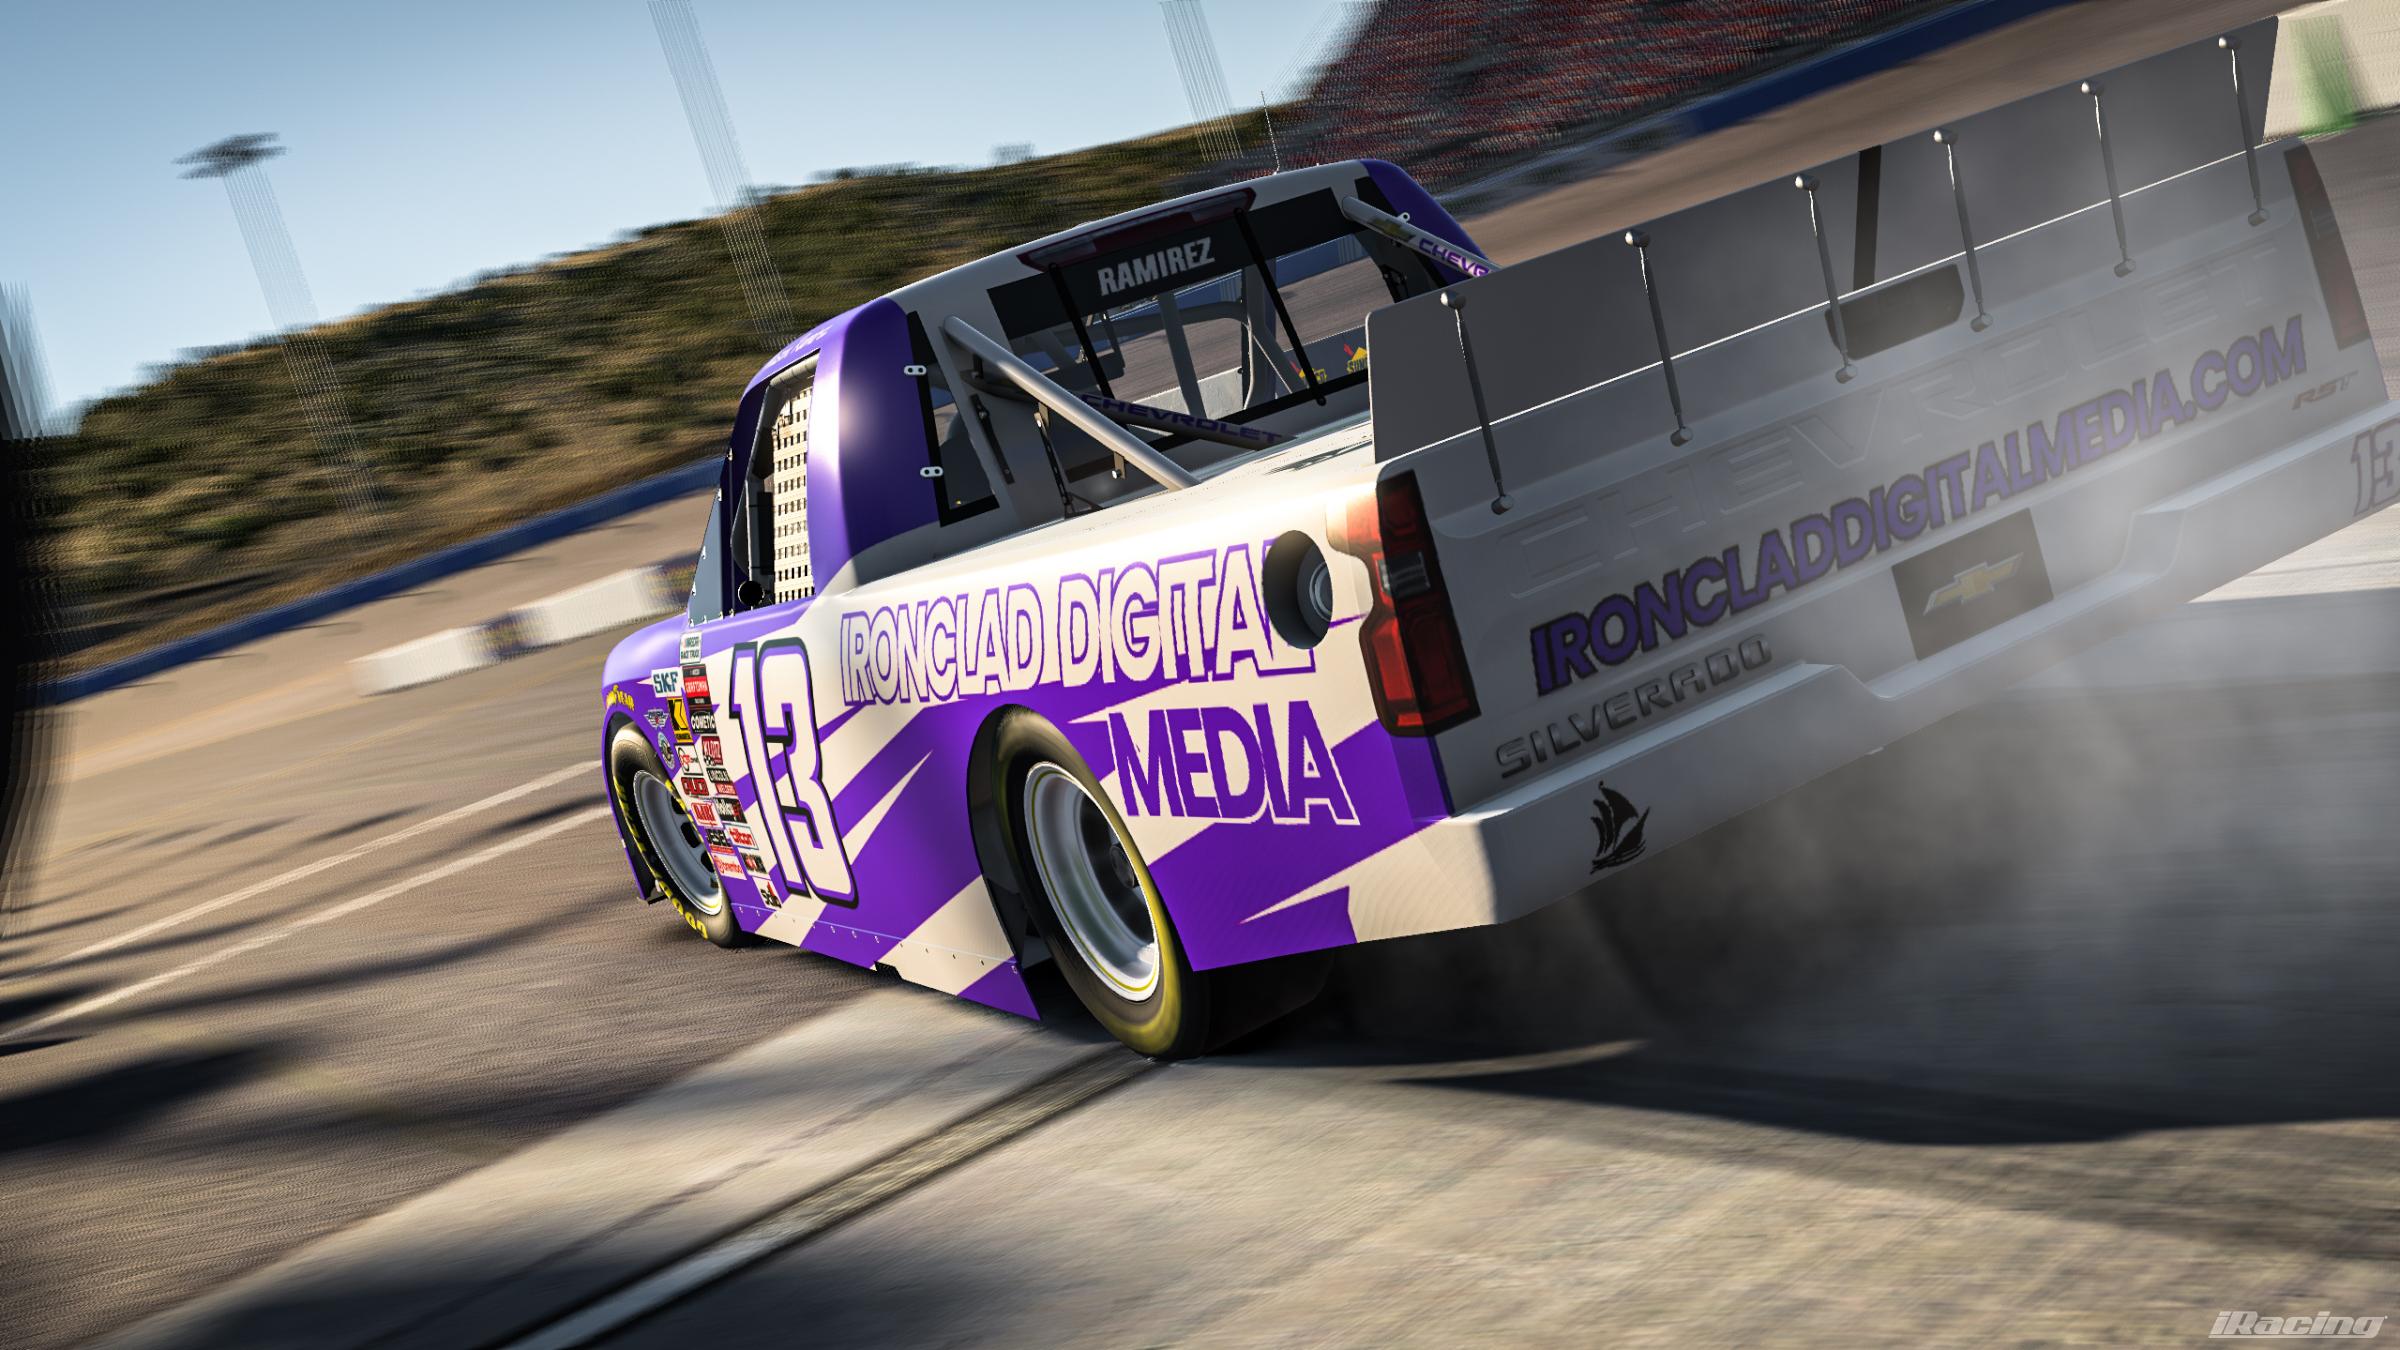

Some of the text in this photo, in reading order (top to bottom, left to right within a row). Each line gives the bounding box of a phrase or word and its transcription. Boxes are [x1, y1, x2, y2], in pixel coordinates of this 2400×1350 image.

[1098, 237, 1215, 297] RAMIREZ
[1418, 237, 1489, 277] CHEVR
[1081, 394, 1283, 444] CHEVROLET
[1530, 314, 2308, 697] IRONCLADDIGITALMEDIA.COM
[653, 671, 678, 693] SKF
[840, 582, 1045, 706] IRONCLAD
[1496, 634, 1772, 777] SILVERADO
[729, 637, 859, 909] 13
[1109, 700, 1360, 825] MEDIA
